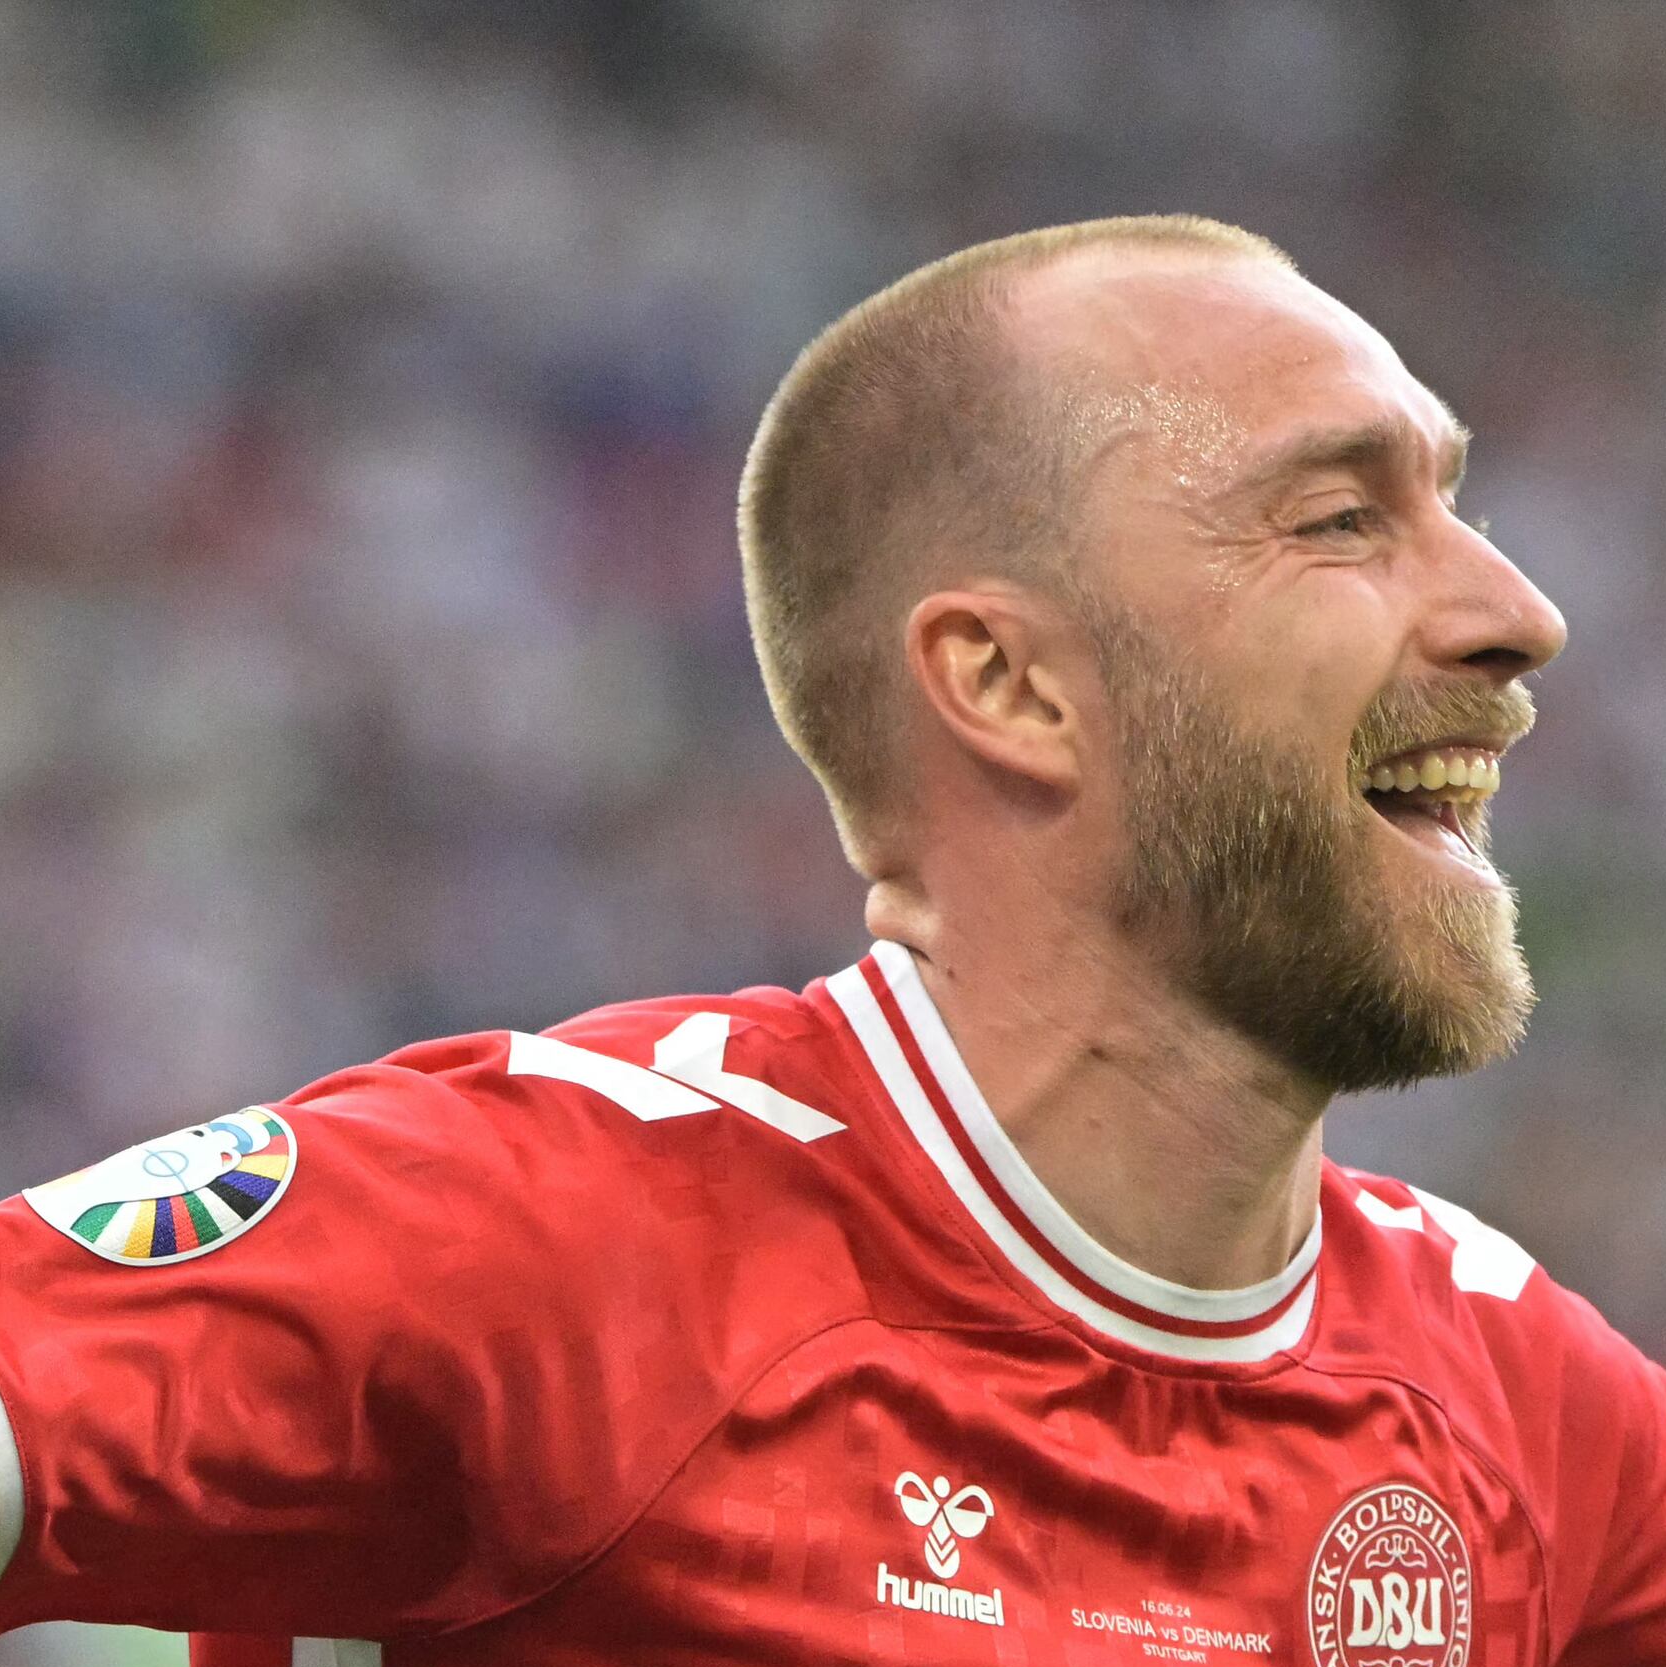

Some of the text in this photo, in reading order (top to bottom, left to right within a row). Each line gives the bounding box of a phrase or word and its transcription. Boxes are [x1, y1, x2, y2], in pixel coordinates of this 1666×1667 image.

[877, 1562, 1005, 1627] hummel
[1141, 1599, 1192, 1619] 16.06.24
[1346, 1572, 1447, 1650] DBU
[1071, 1608, 1272, 1654] SLOVENIA vs DENMARK
[1142, 1643, 1208, 1664] STUTTGART
